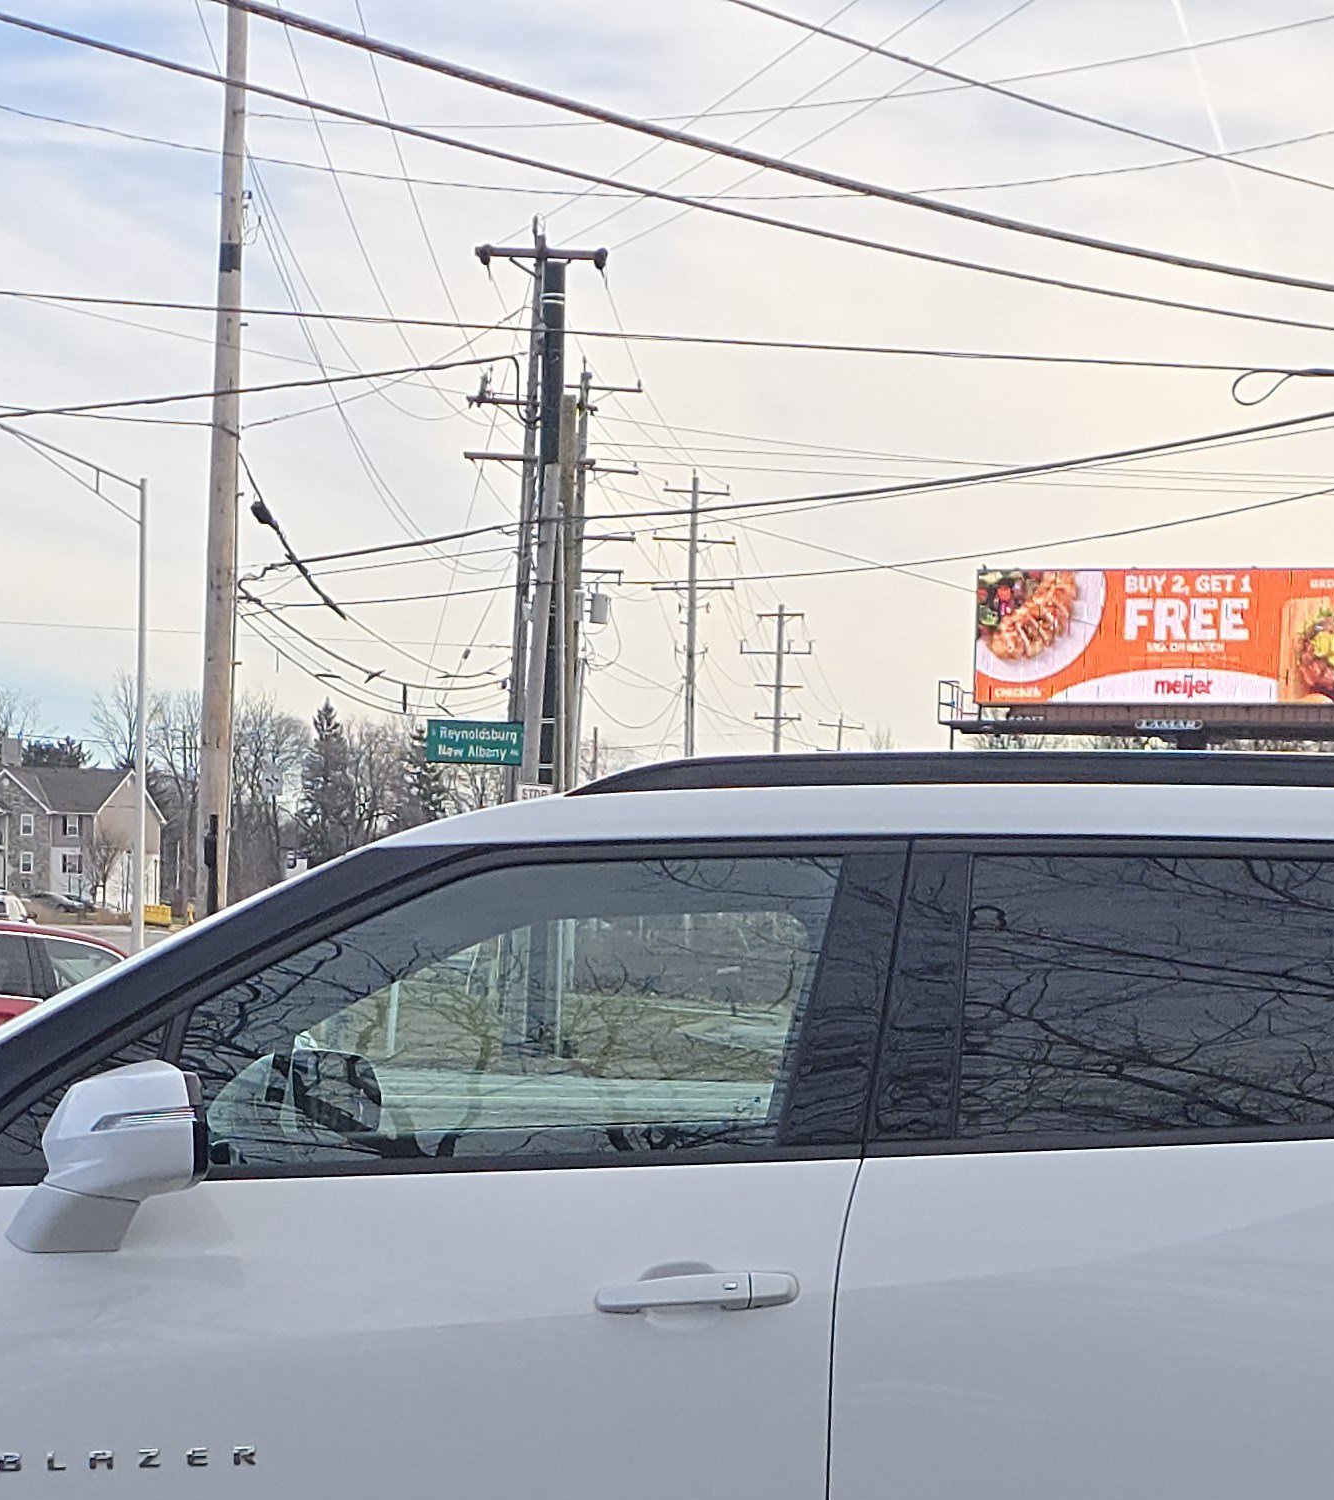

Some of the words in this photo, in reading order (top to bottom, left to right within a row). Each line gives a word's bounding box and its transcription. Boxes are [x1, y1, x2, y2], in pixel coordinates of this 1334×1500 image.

[1124, 574, 1166, 593] BUY
[1171, 575, 1190, 595] 2,
[1195, 574, 1235, 593] GET
[1240, 574, 1252, 593] 1
[1124, 597, 1250, 641] FREE
[1154, 675, 1213, 698] meijer
[439, 726, 518, 745] Reynoldsburg
[437, 744, 464, 758] New
[468, 744, 507, 761] Albany
